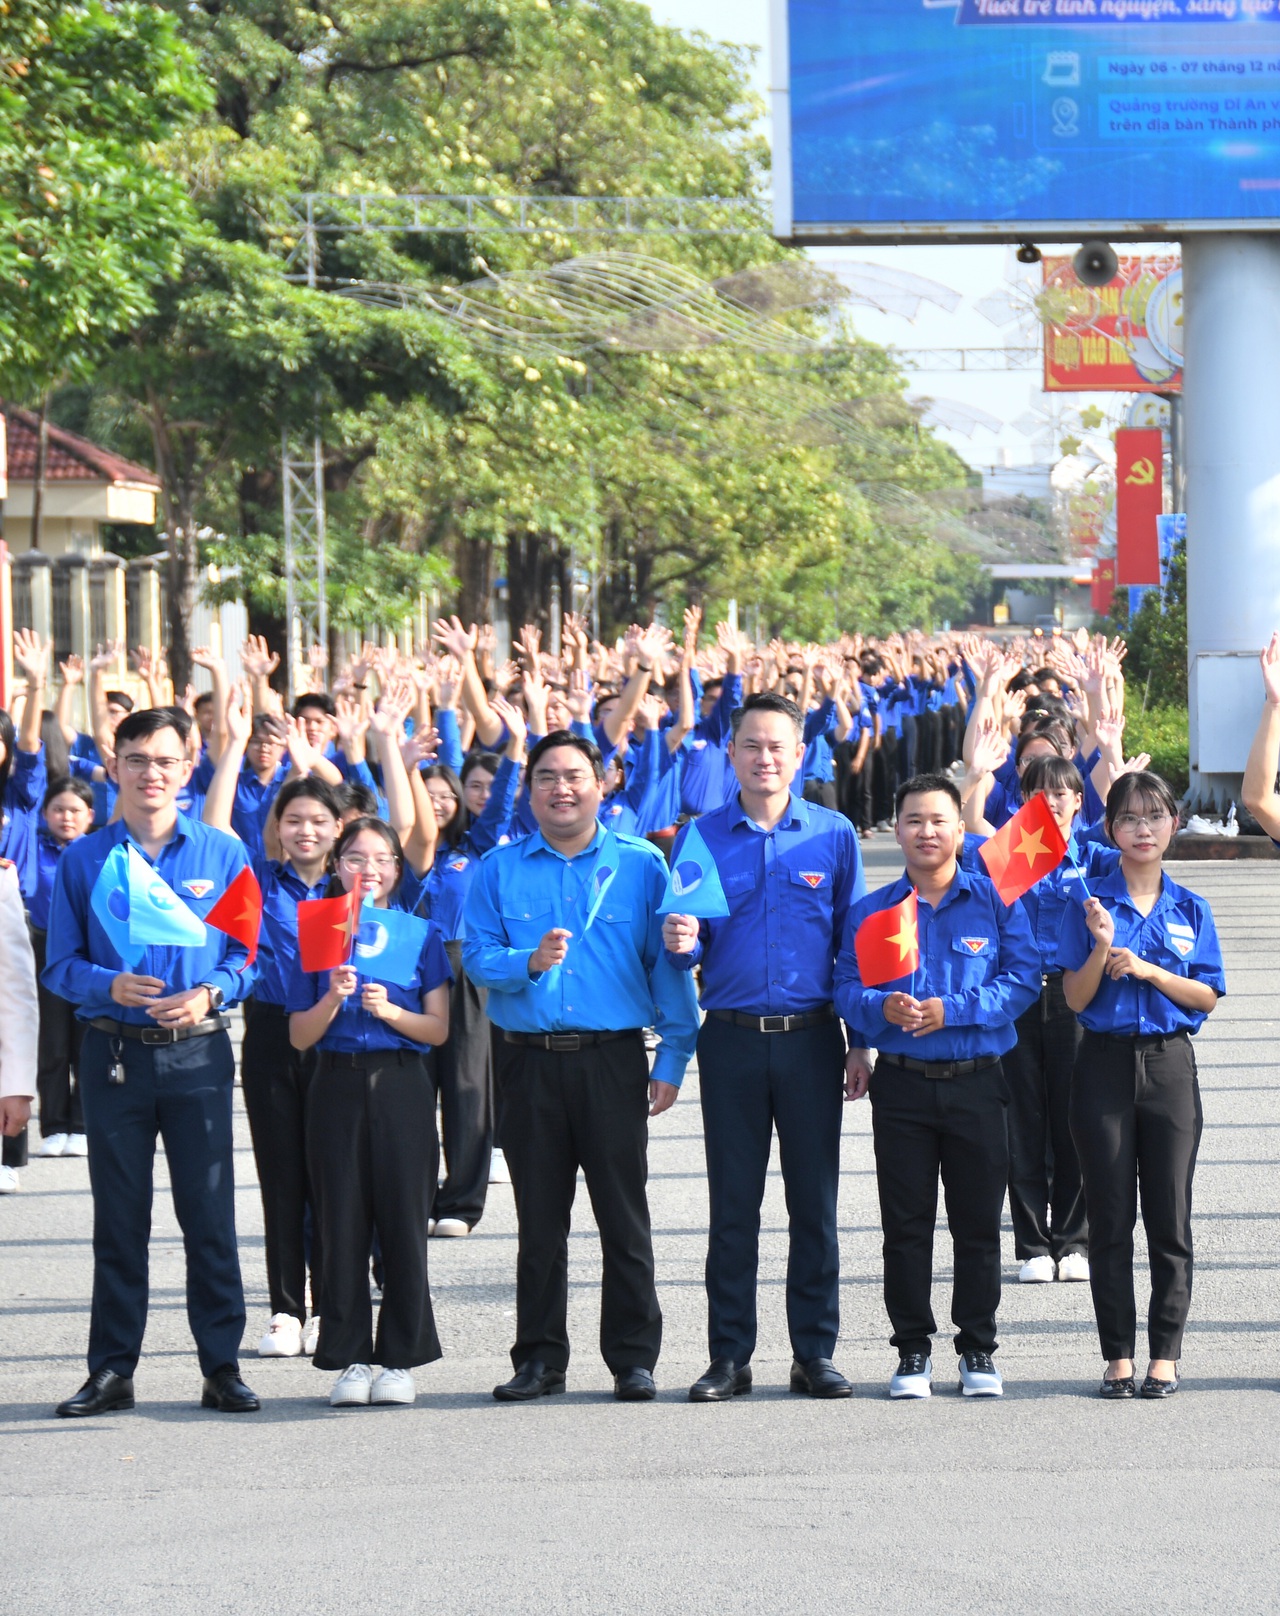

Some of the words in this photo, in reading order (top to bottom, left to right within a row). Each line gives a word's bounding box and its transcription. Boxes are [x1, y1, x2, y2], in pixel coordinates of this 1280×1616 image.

[1108, 61, 1145, 75] Ngày
[1150, 61, 1168, 73] 06
[1181, 61, 1199, 73] 07
[1203, 60, 1246, 74] tháng
[1249, 60, 1264, 72] 12
[1245, 98, 1266, 110] An
[1109, 118, 1142, 131] trên
[1146, 118, 1170, 133] địa
[1175, 118, 1204, 130] bàn
[1208, 118, 1257, 130] Thành
